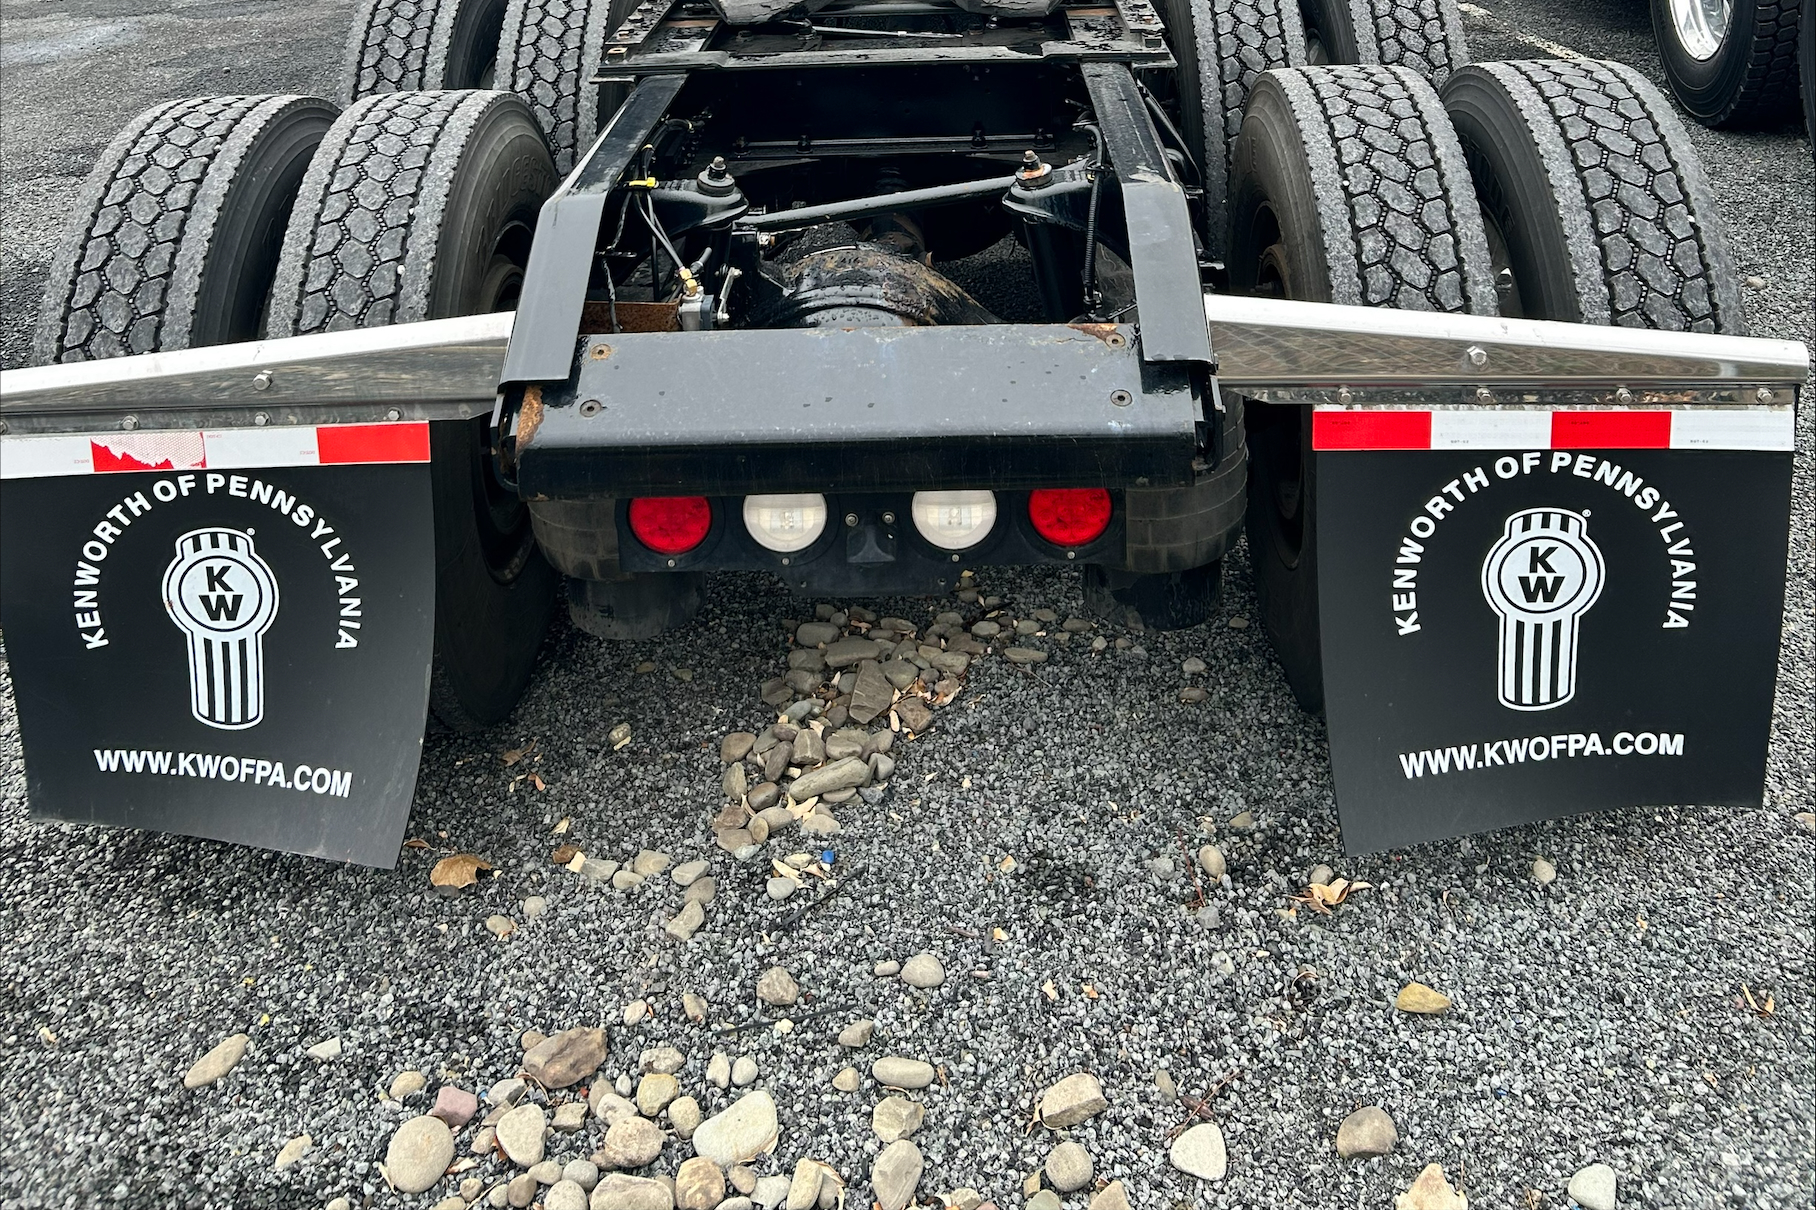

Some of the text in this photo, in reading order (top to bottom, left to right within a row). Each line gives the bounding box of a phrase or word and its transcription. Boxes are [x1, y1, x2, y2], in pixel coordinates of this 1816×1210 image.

[74, 474, 361, 649] KENWORTH OF PENNSYLVANIA
[1393, 452, 1696, 635] KENWORTH OF PENNSYLVANIA
[94, 750, 352, 798] WWW.KWOFPA.COM
[1399, 733, 1684, 779] WWW.KWOFPA.COM
